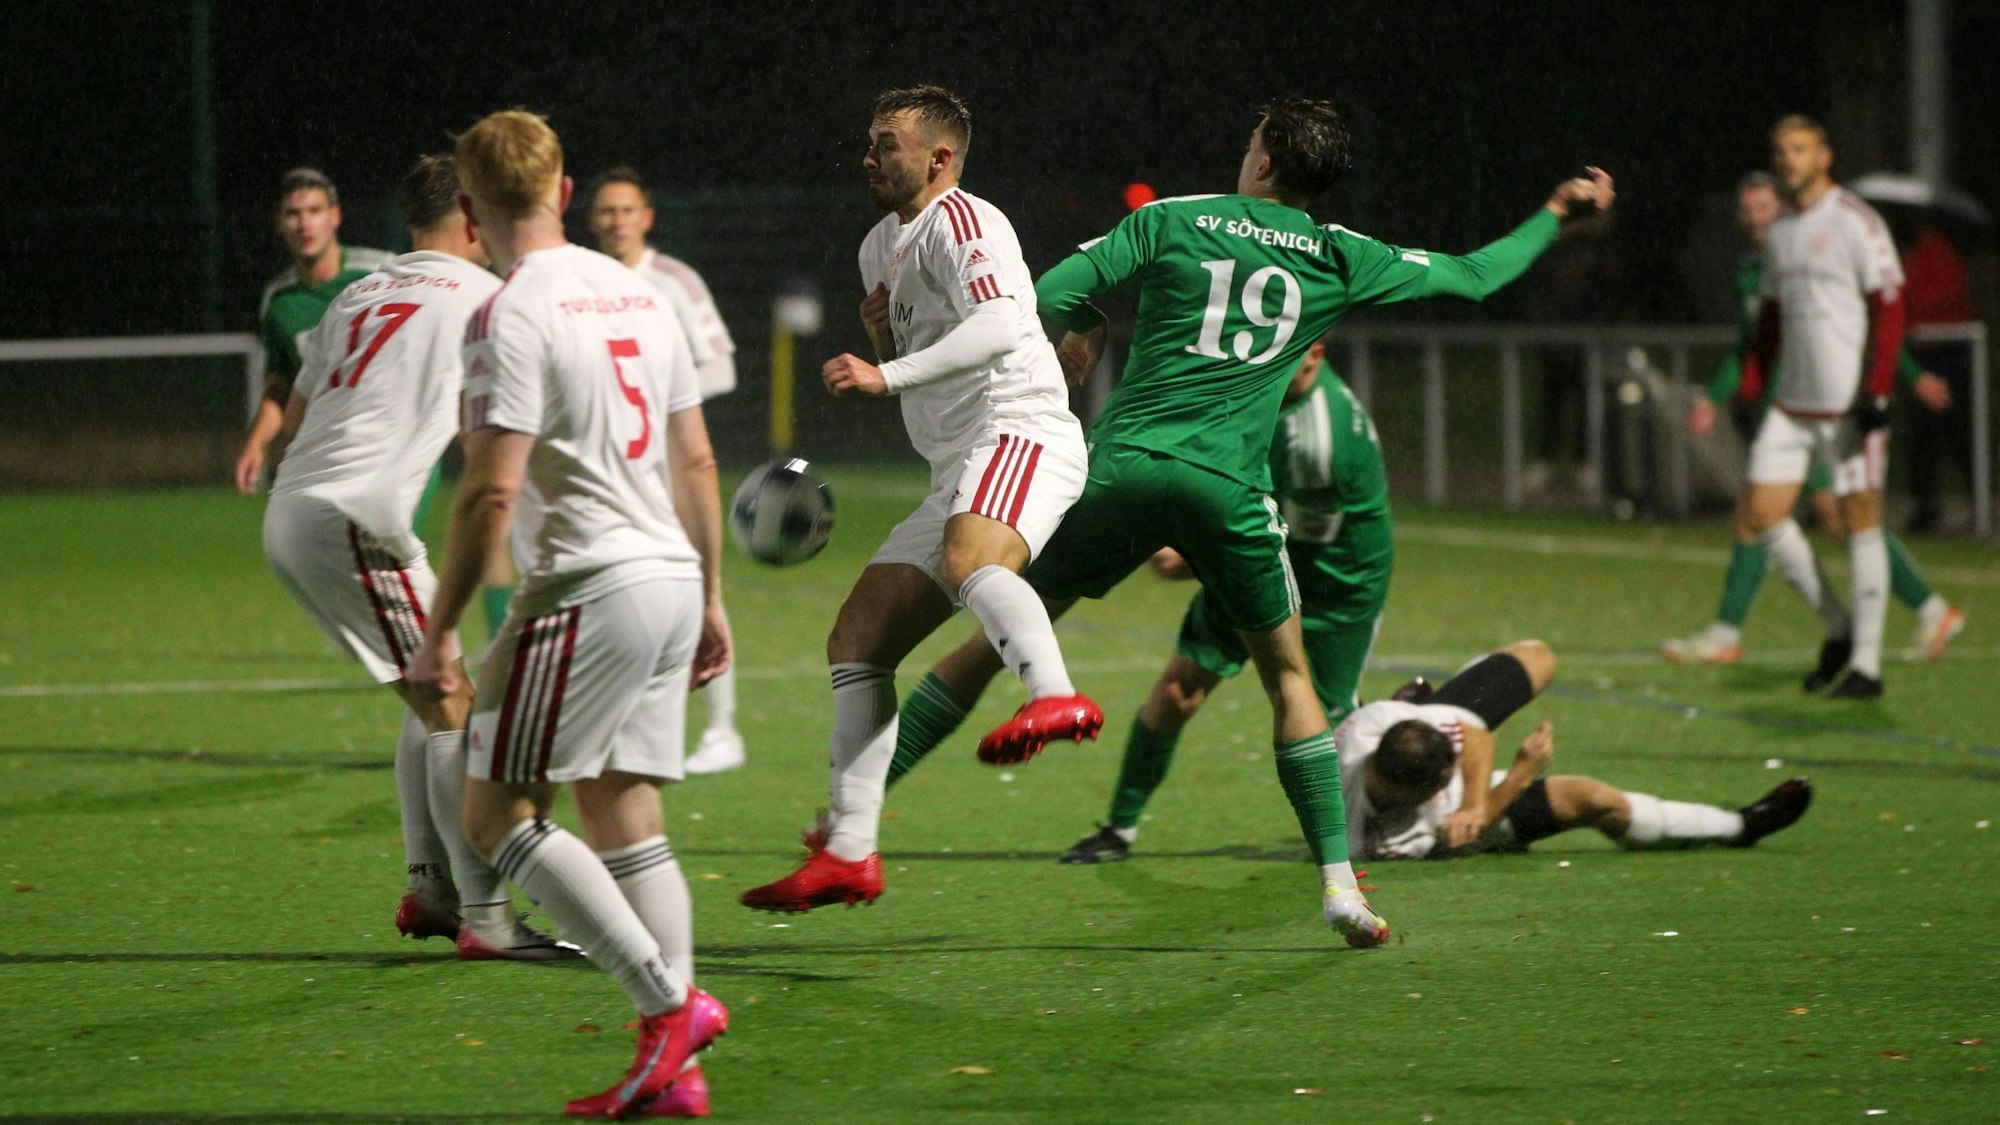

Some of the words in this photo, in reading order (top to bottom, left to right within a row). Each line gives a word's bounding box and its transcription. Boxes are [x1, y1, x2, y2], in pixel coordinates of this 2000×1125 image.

[1196, 214, 1222, 231] SV
[1225, 218, 1321, 256] SÖTENICH
[329, 303, 425, 389] 17
[1184, 259, 1302, 364] 19
[606, 338, 653, 461] 5
